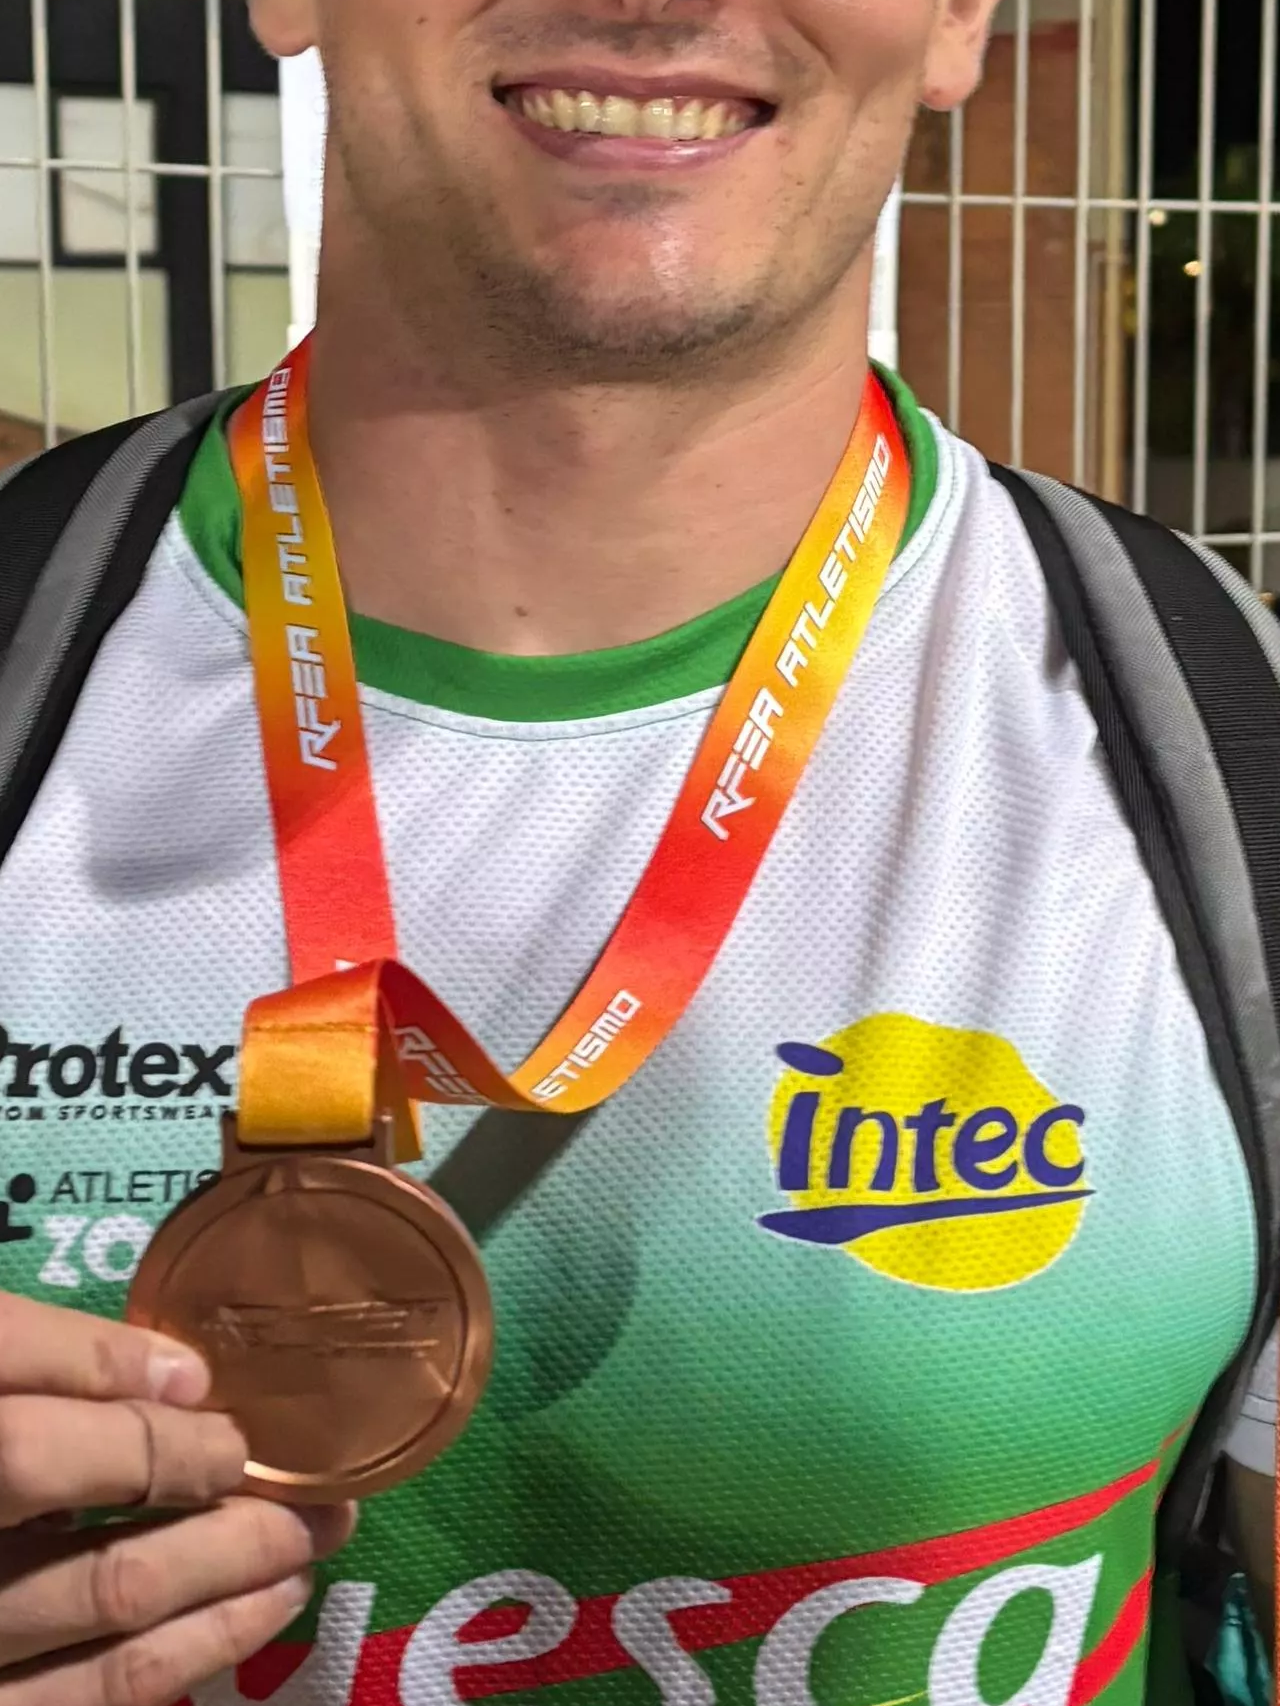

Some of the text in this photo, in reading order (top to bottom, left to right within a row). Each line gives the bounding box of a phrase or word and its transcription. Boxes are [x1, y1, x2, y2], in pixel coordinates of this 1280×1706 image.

[262, 367, 342, 771] RFEA ATLETISMO
[700, 432, 892, 841] RFEA ATLETISMO
[58, 1104, 231, 1122] SPORTSWEA
[50, 1169, 222, 1204] ATLETI
[37, 1213, 156, 1288] ZO
